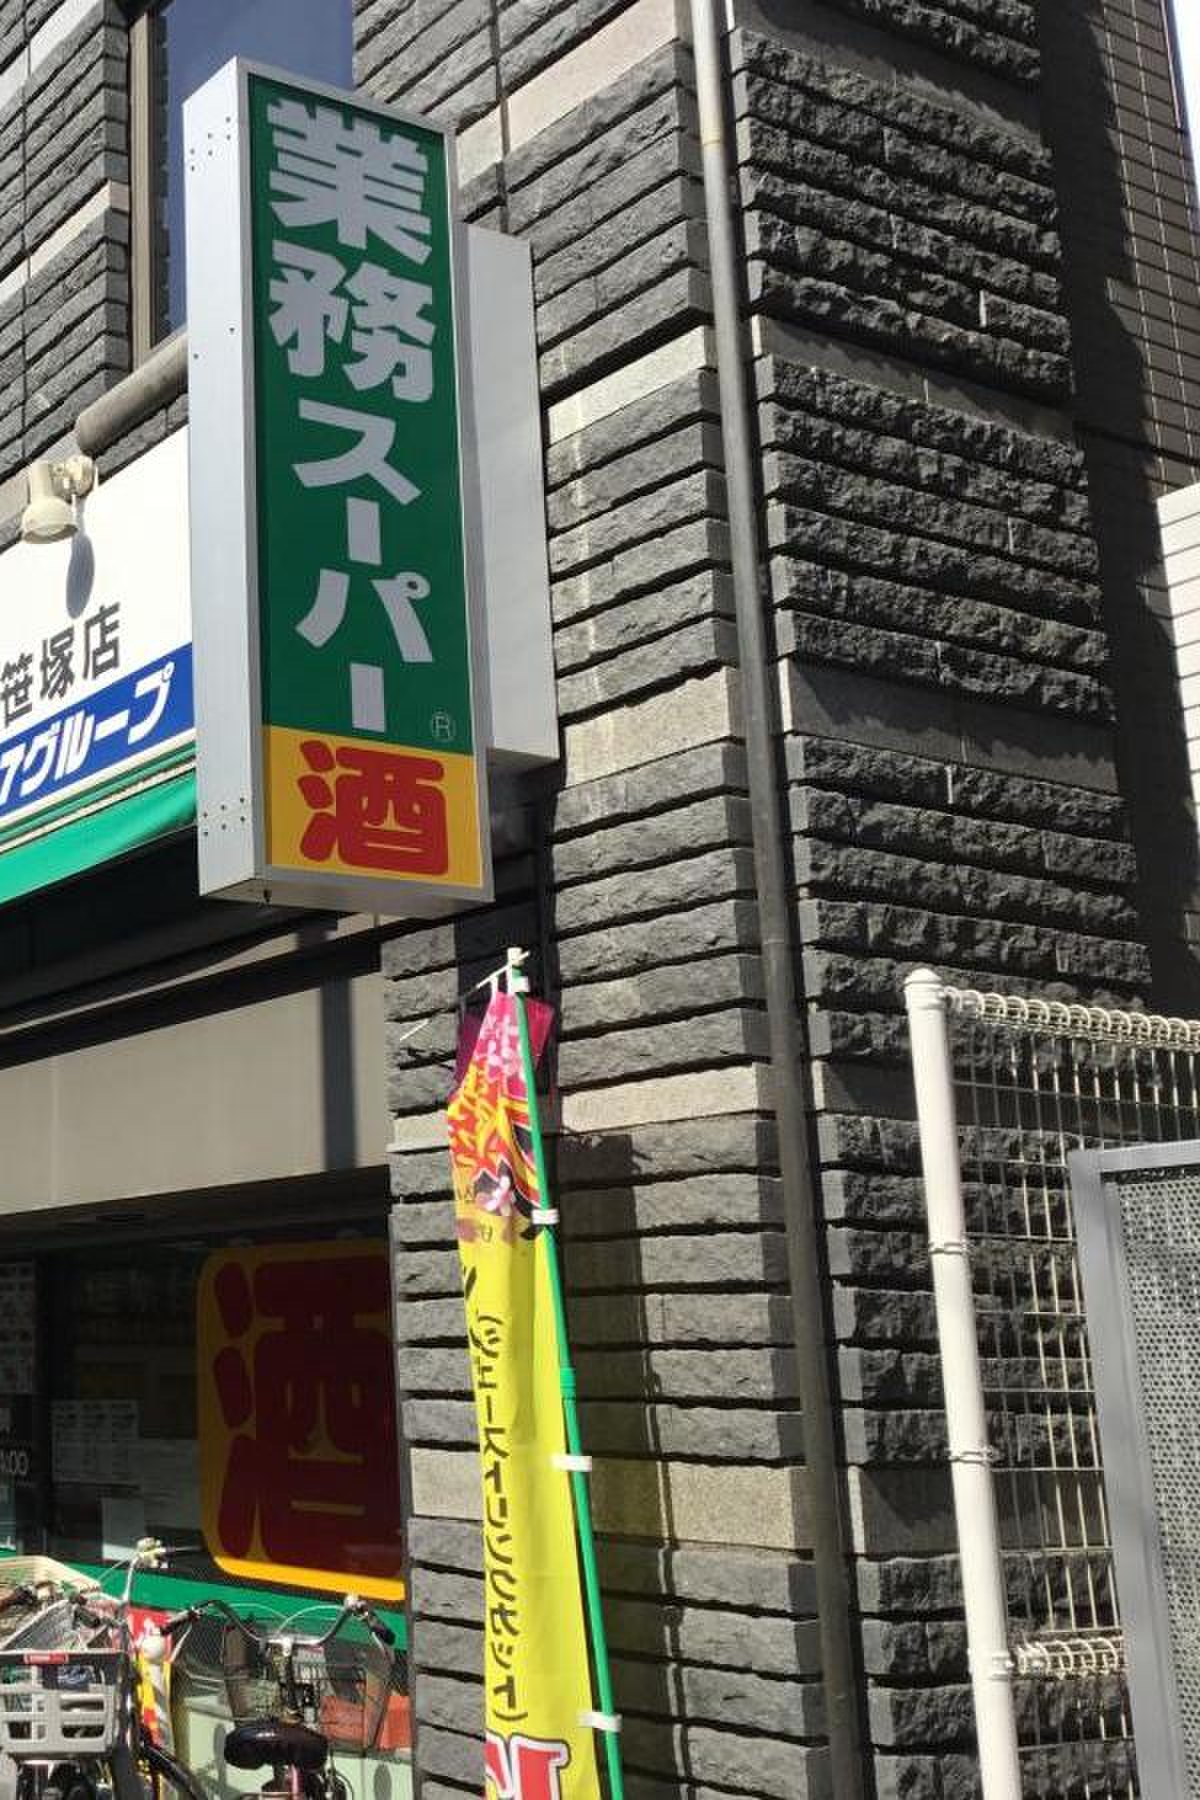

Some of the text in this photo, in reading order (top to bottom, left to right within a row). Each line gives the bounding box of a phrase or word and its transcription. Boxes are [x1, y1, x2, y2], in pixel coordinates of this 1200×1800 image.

[267, 98, 436, 733] 業務スーパー
[0, 602, 120, 728] 笹塚店
[297, 739, 449, 877] 酒
[213, 1256, 400, 1578] 酒
